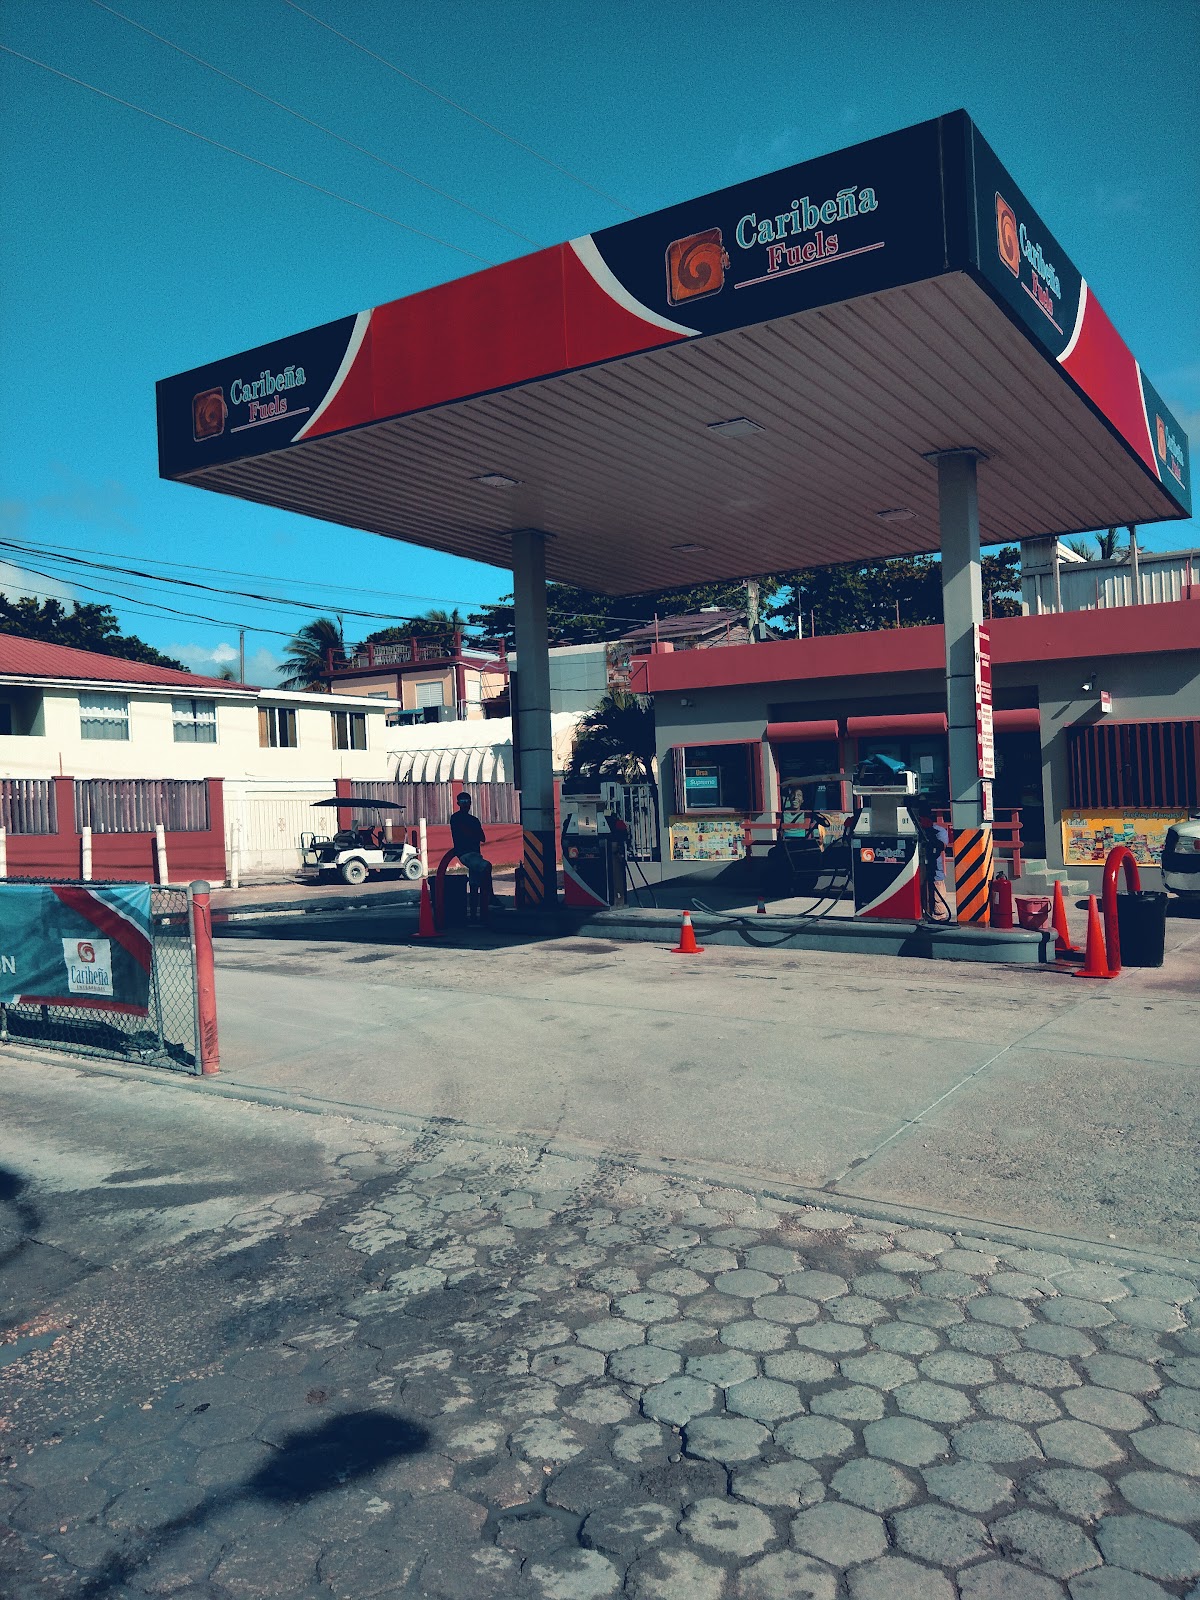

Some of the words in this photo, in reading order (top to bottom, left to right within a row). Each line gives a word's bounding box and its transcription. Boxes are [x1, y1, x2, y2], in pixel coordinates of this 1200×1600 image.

[735, 185, 879, 250] Caribeña
[766, 231, 839, 273] Fuels
[1019, 222, 1062, 300] Caribeña
[230, 365, 307, 405] Caribeña
[248, 395, 288, 422] Fuels
[71, 965, 109, 985] Caribeña
